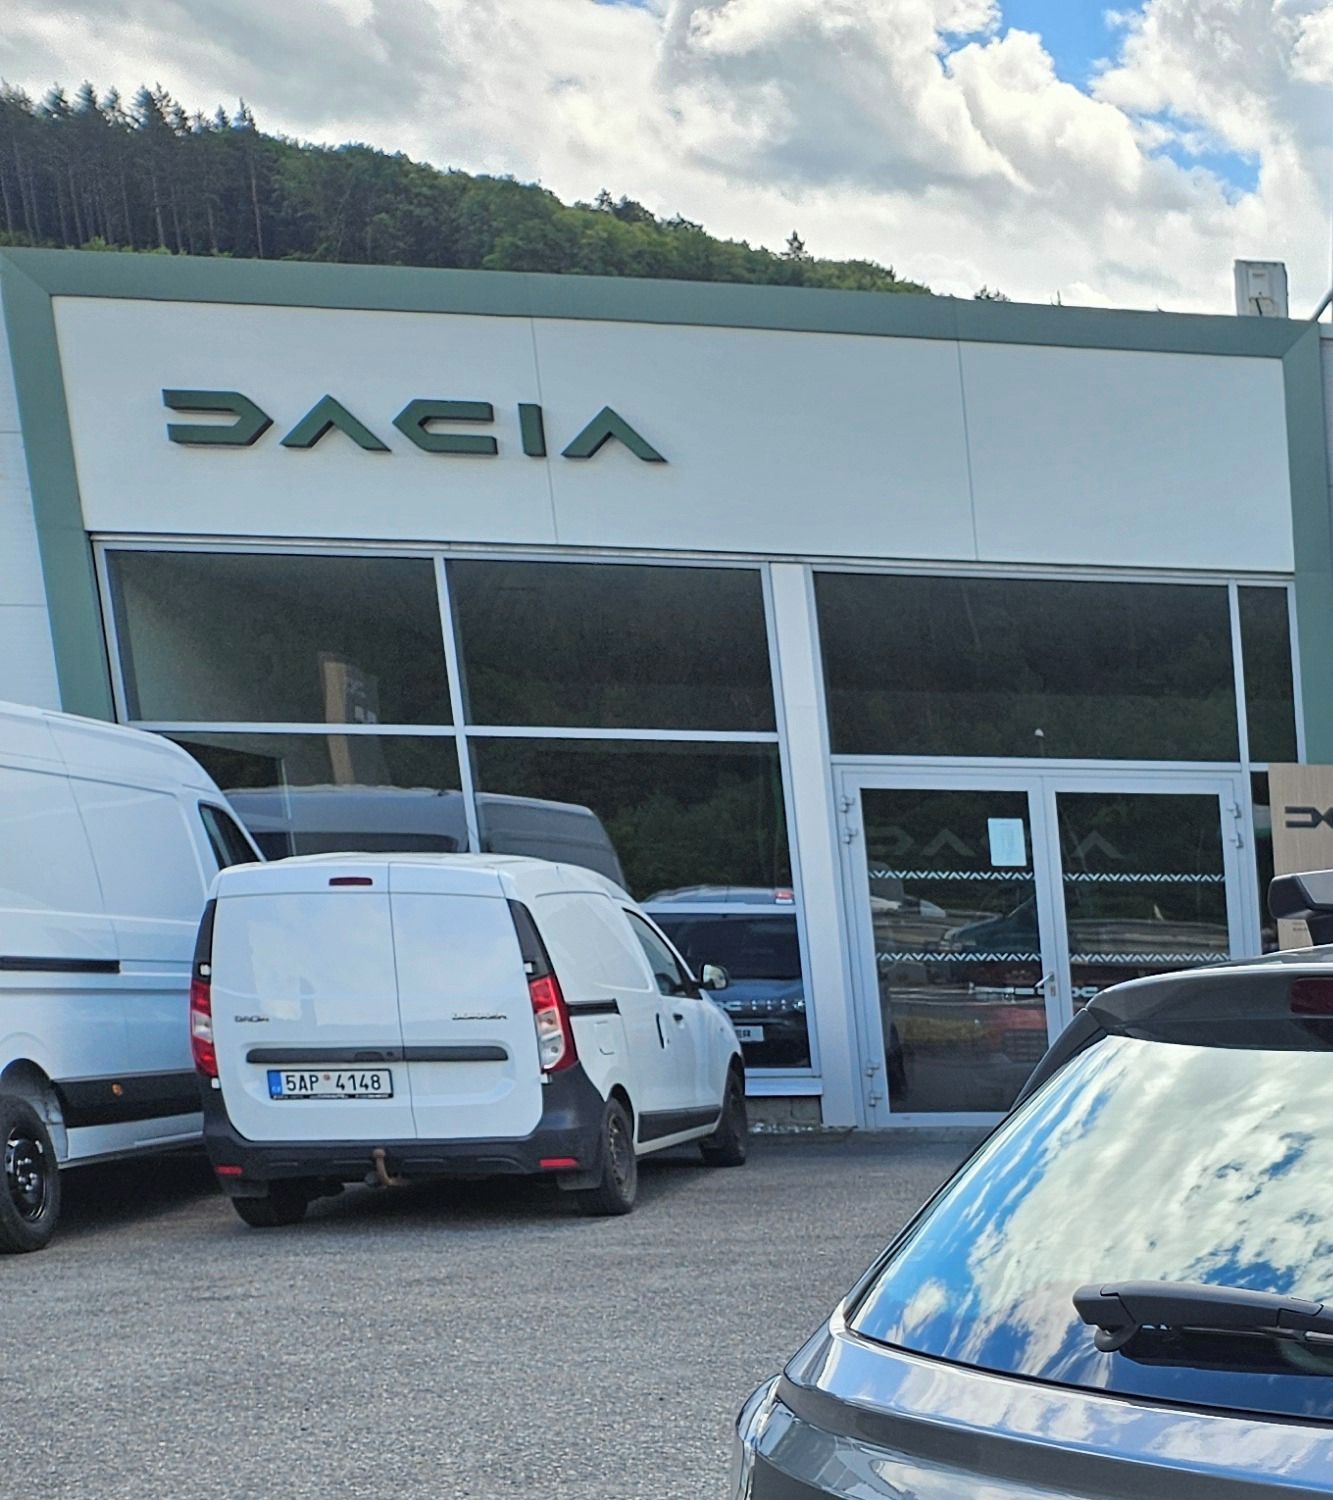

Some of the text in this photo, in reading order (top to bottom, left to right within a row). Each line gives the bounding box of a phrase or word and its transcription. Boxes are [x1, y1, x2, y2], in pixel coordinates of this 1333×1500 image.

[162, 388, 669, 464] DACIA
[285, 1073, 382, 1092] 5AP 4148
